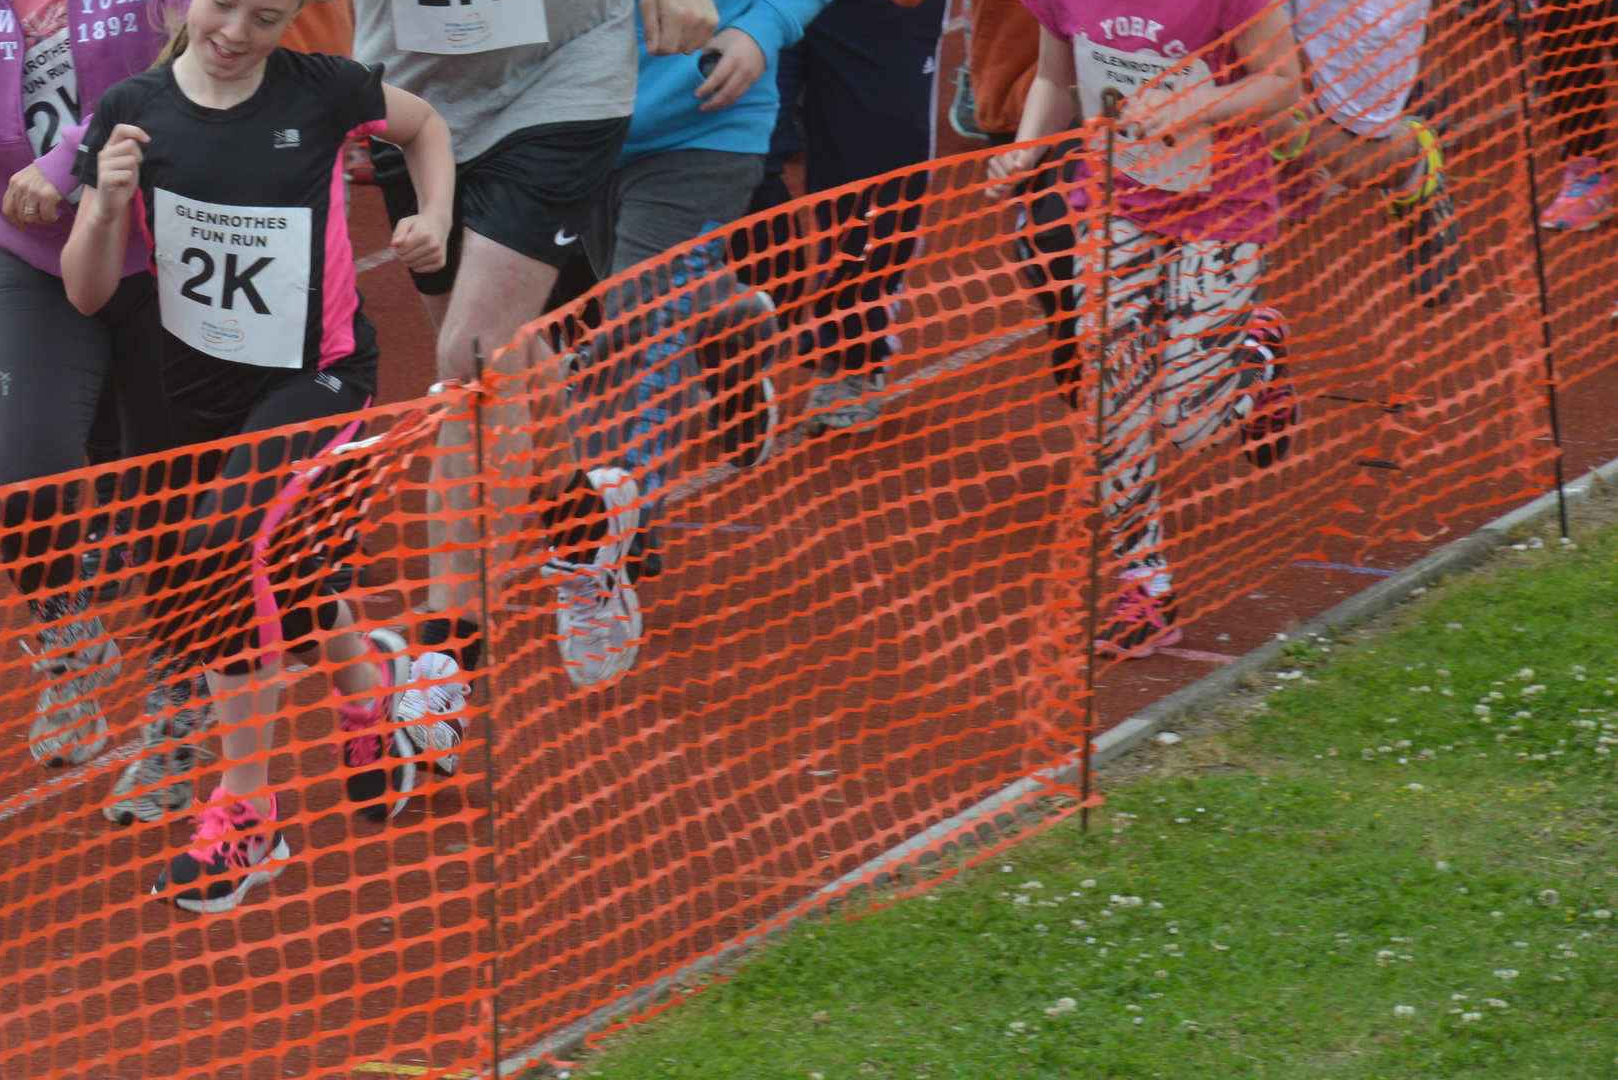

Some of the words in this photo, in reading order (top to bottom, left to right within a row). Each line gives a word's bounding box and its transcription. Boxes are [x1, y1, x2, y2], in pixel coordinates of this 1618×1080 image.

[76, 12, 139, 44] 1892
[1099, 15, 1165, 43] YORK
[1106, 69, 1136, 87] FUN
[174, 204, 289, 231] GLENROTHES
[190, 226, 225, 244] FUN
[229, 233, 268, 248] RUN
[179, 246, 277, 316] 2K
